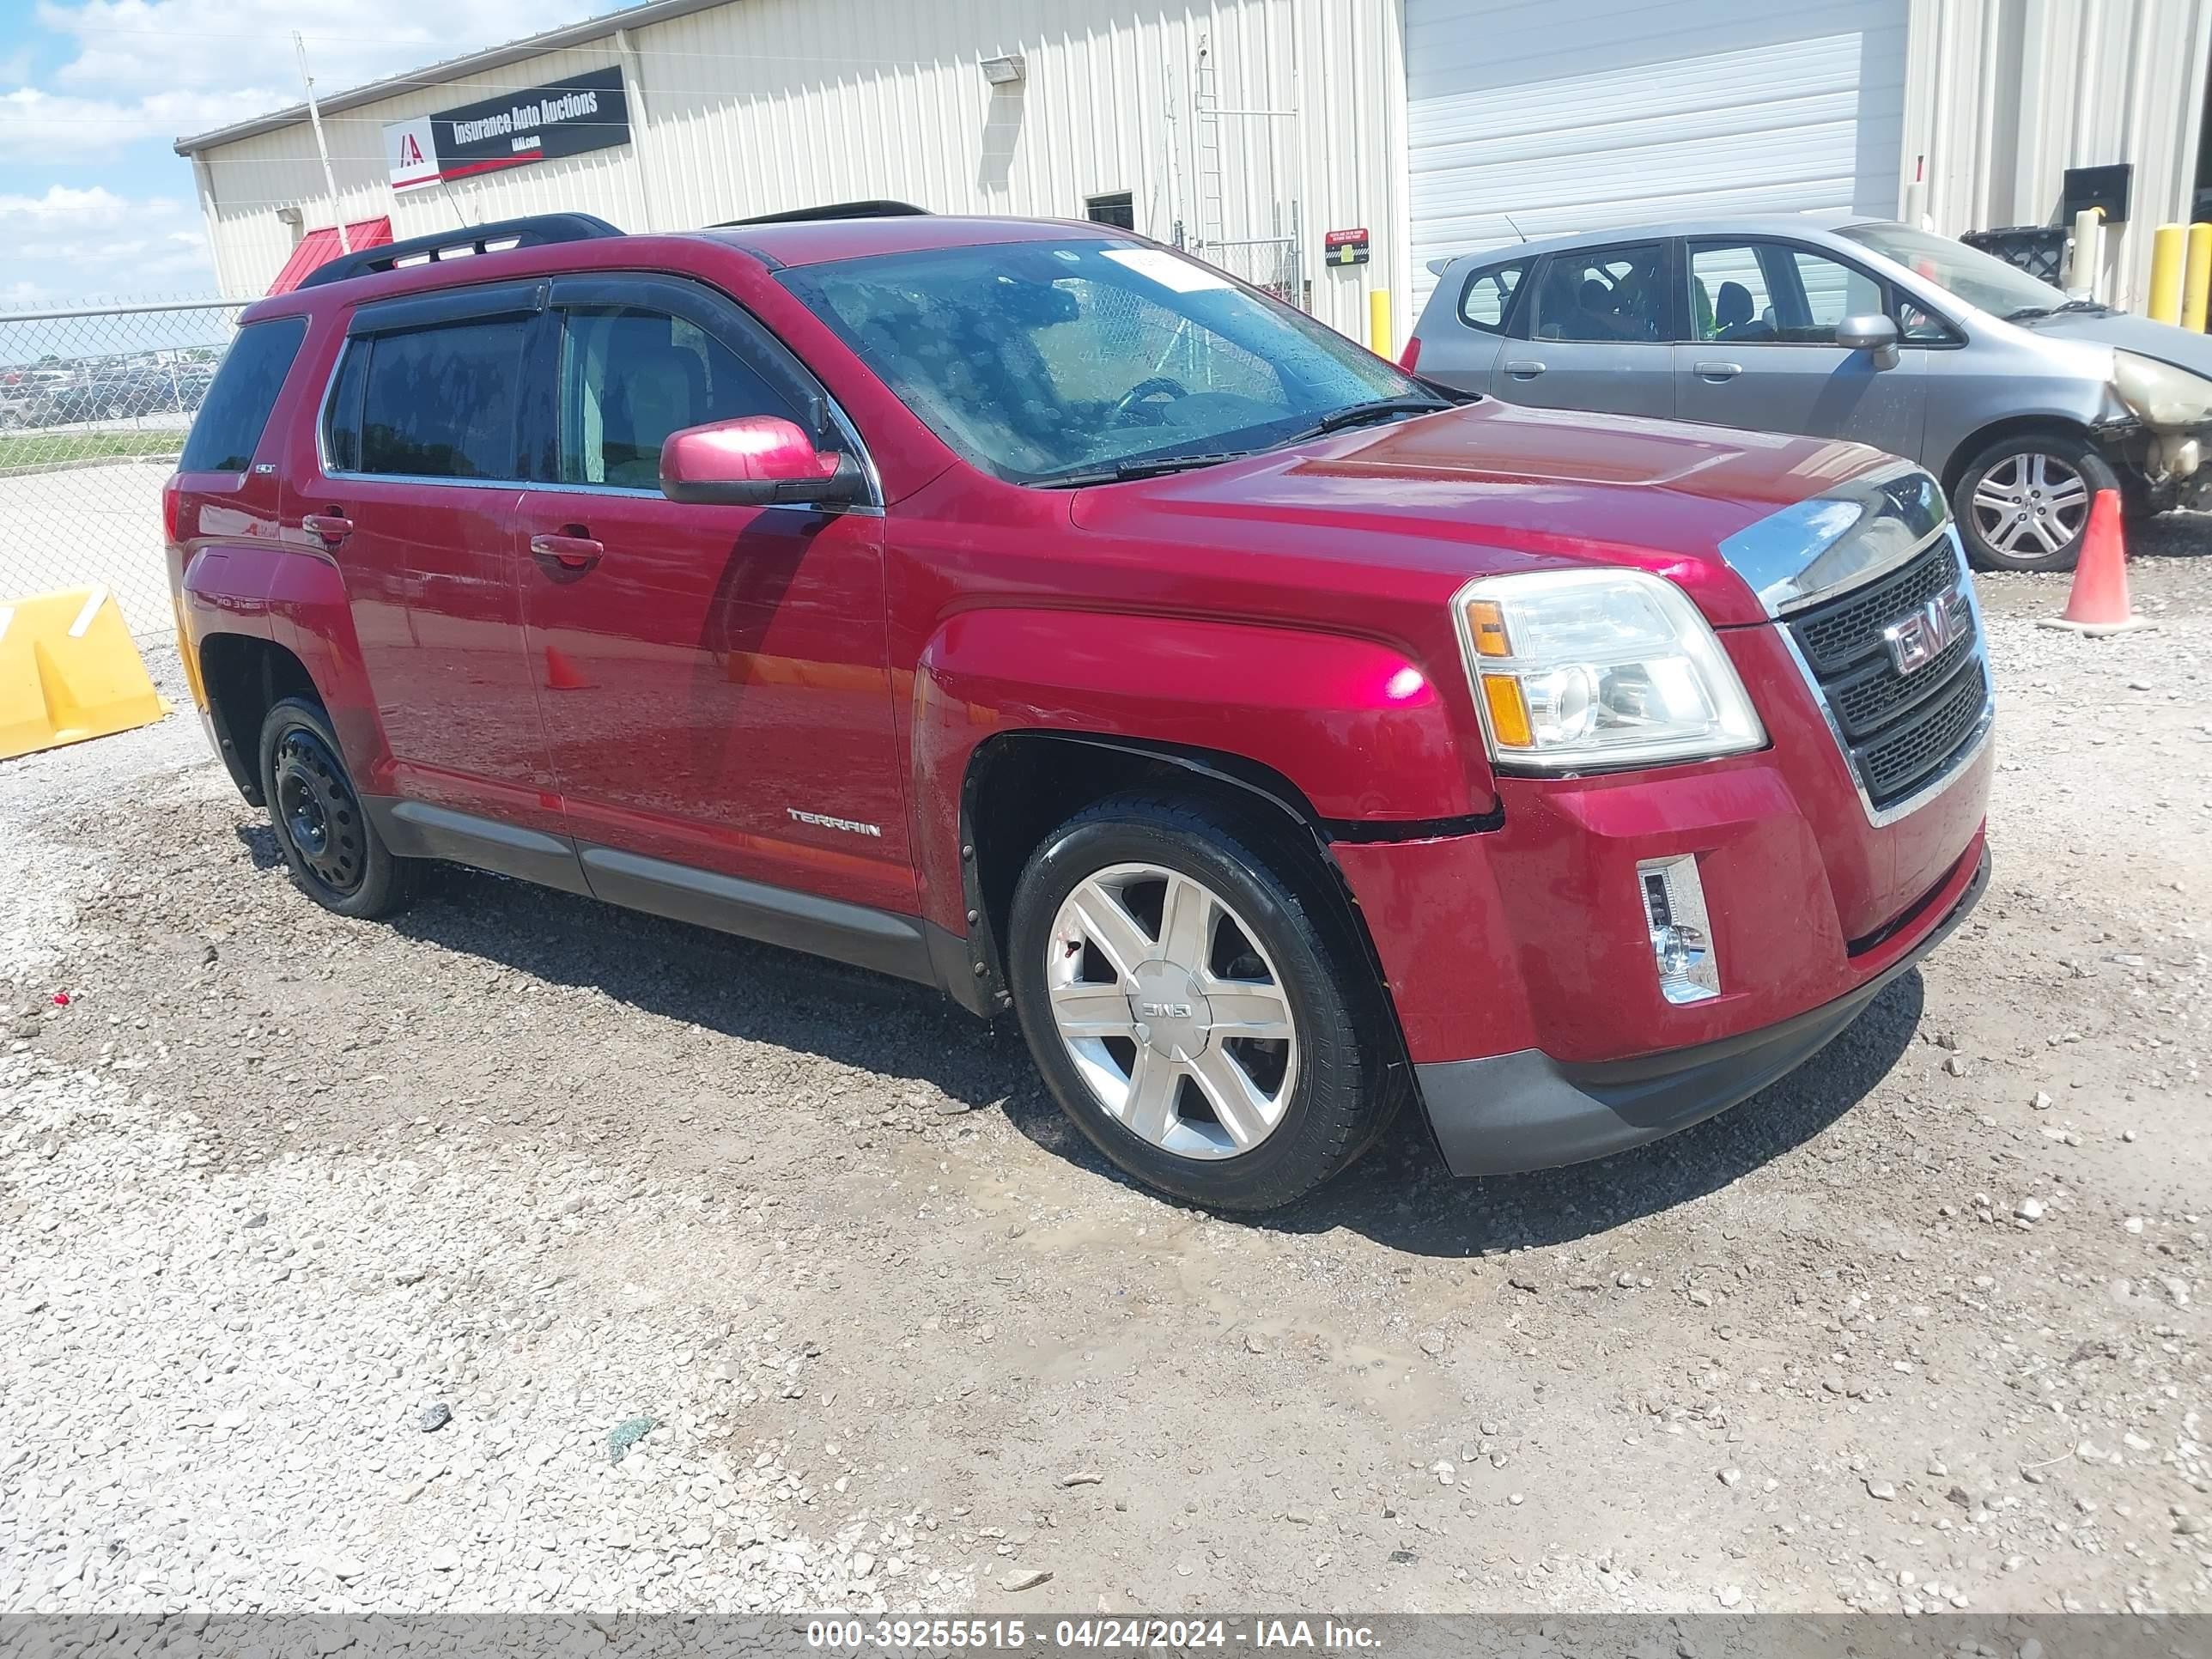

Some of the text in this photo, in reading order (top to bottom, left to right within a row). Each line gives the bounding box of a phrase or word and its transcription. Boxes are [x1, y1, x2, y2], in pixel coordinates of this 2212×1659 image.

[453, 91, 598, 145] Insurance Auto Auctions
[1884, 584, 1967, 675] GMC
[787, 807, 881, 837] TERRAIN
[1142, 1002, 1192, 1018] GMC
